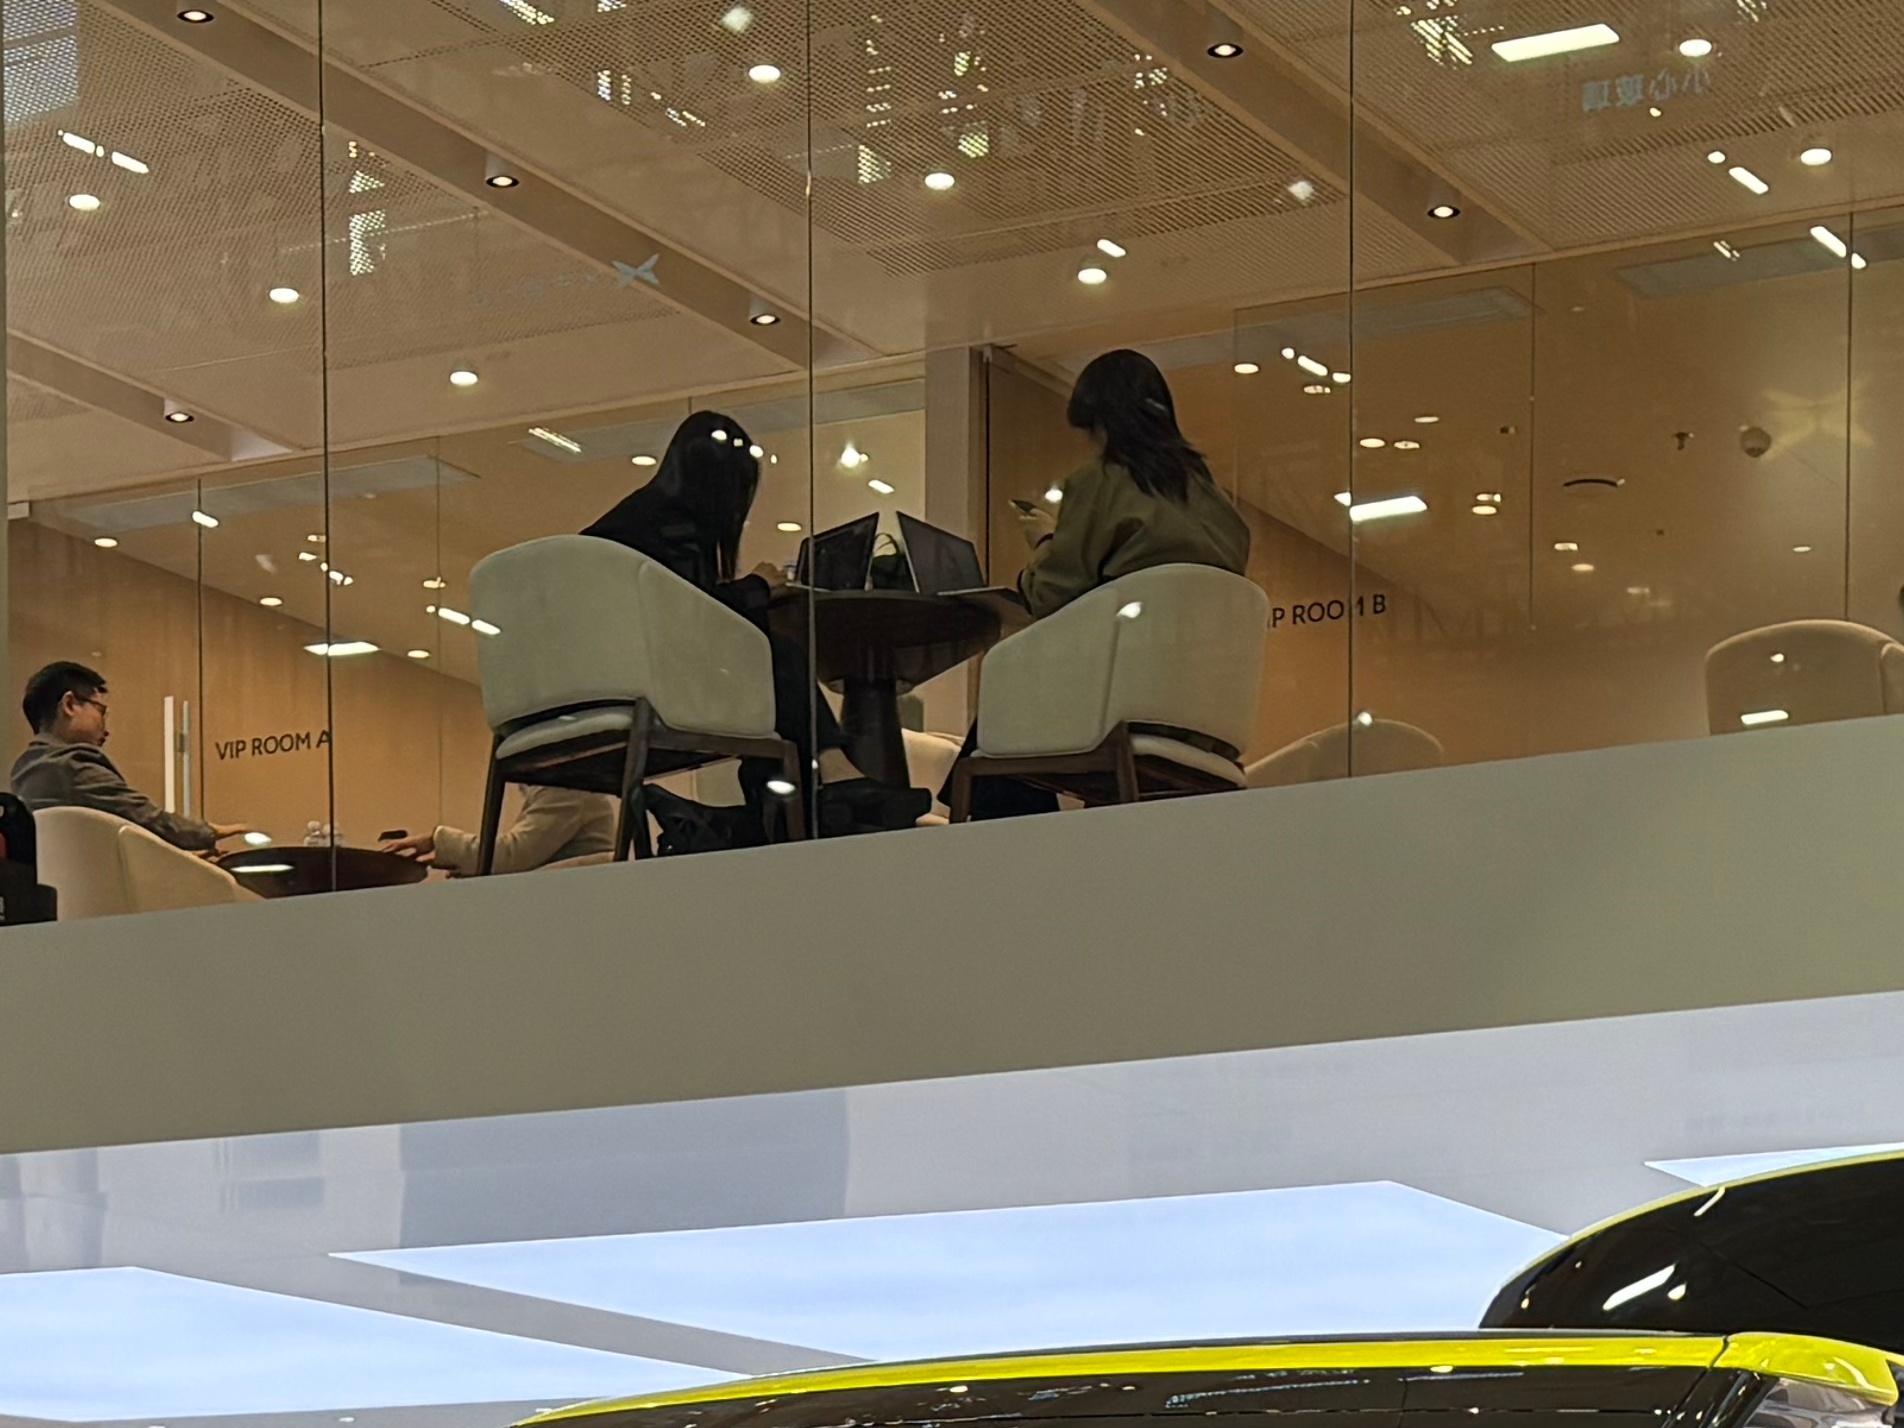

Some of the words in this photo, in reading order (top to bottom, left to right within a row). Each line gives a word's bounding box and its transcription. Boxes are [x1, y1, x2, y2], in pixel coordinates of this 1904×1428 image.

[1372, 594, 1386, 615] B
[215, 740, 246, 760] VIP
[252, 731, 311, 756] ROOM
[316, 729, 332, 748] A
